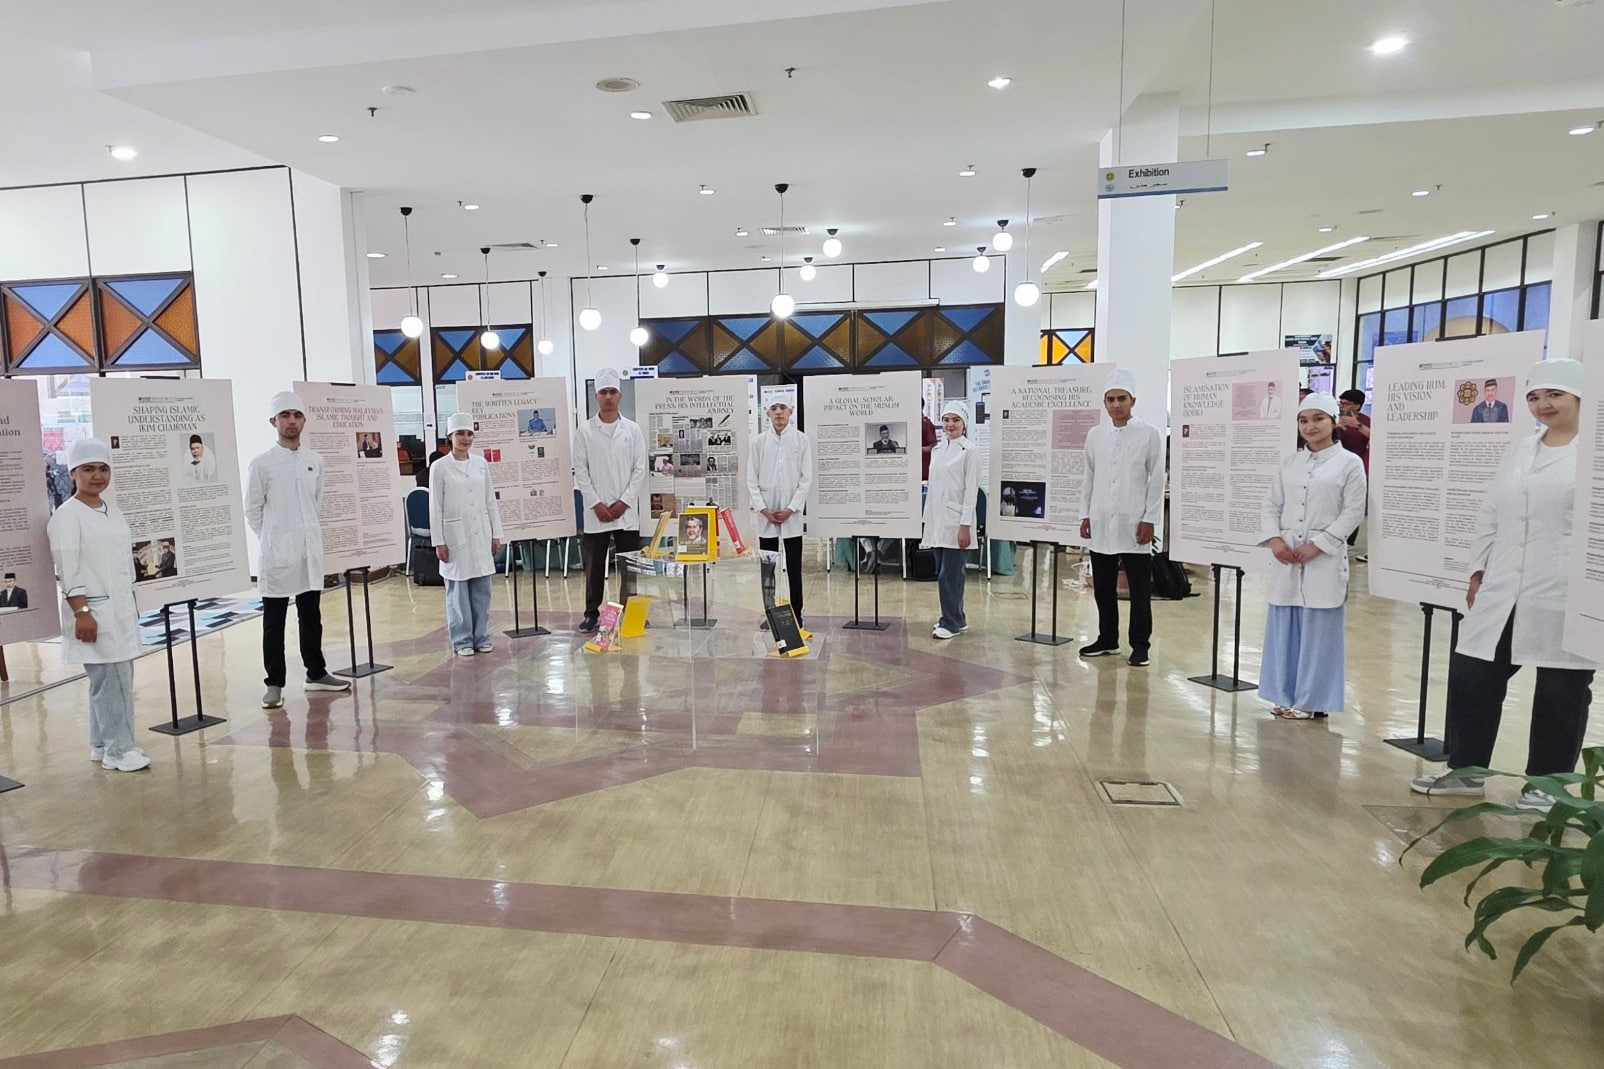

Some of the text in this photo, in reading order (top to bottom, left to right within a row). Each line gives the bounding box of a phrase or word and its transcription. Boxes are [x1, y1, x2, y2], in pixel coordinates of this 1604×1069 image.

[1128, 168, 1170, 178] Exhibition
[1388, 382, 1424, 392] LEADING
[1404, 391, 1432, 401] VISION
[133, 404, 200, 414] SHAPING ISLAMIC
[1387, 403, 1405, 411] AND
[128, 414, 206, 424] UNDERSTANDING AS
[1387, 412, 1438, 422] LEADERSHIP
[0, 428, 20, 436] tion
[158, 423, 198, 431] CHAIRMAN
